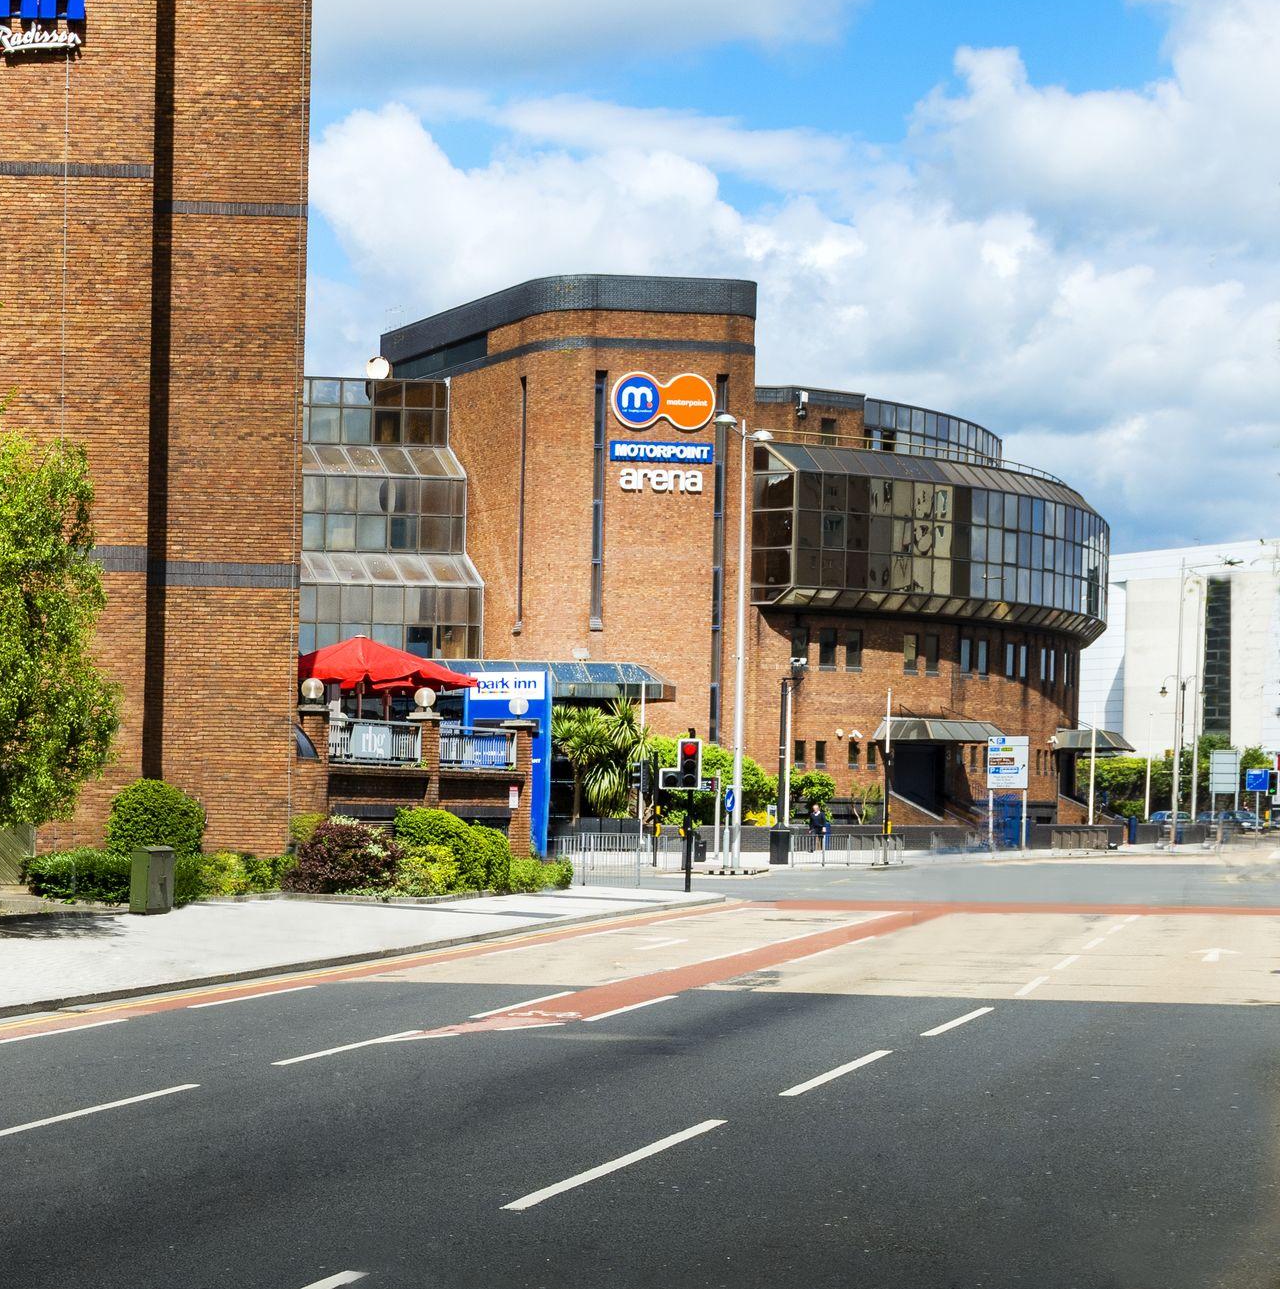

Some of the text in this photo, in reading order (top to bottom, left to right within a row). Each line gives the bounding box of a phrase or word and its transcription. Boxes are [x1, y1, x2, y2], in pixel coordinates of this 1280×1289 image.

[666, 399, 709, 407] motorpoint
[614, 443, 711, 459] MOTORPOINT
[619, 467, 703, 493] arena
[477, 677, 537, 694] park inn
[361, 725, 386, 759] rbg
